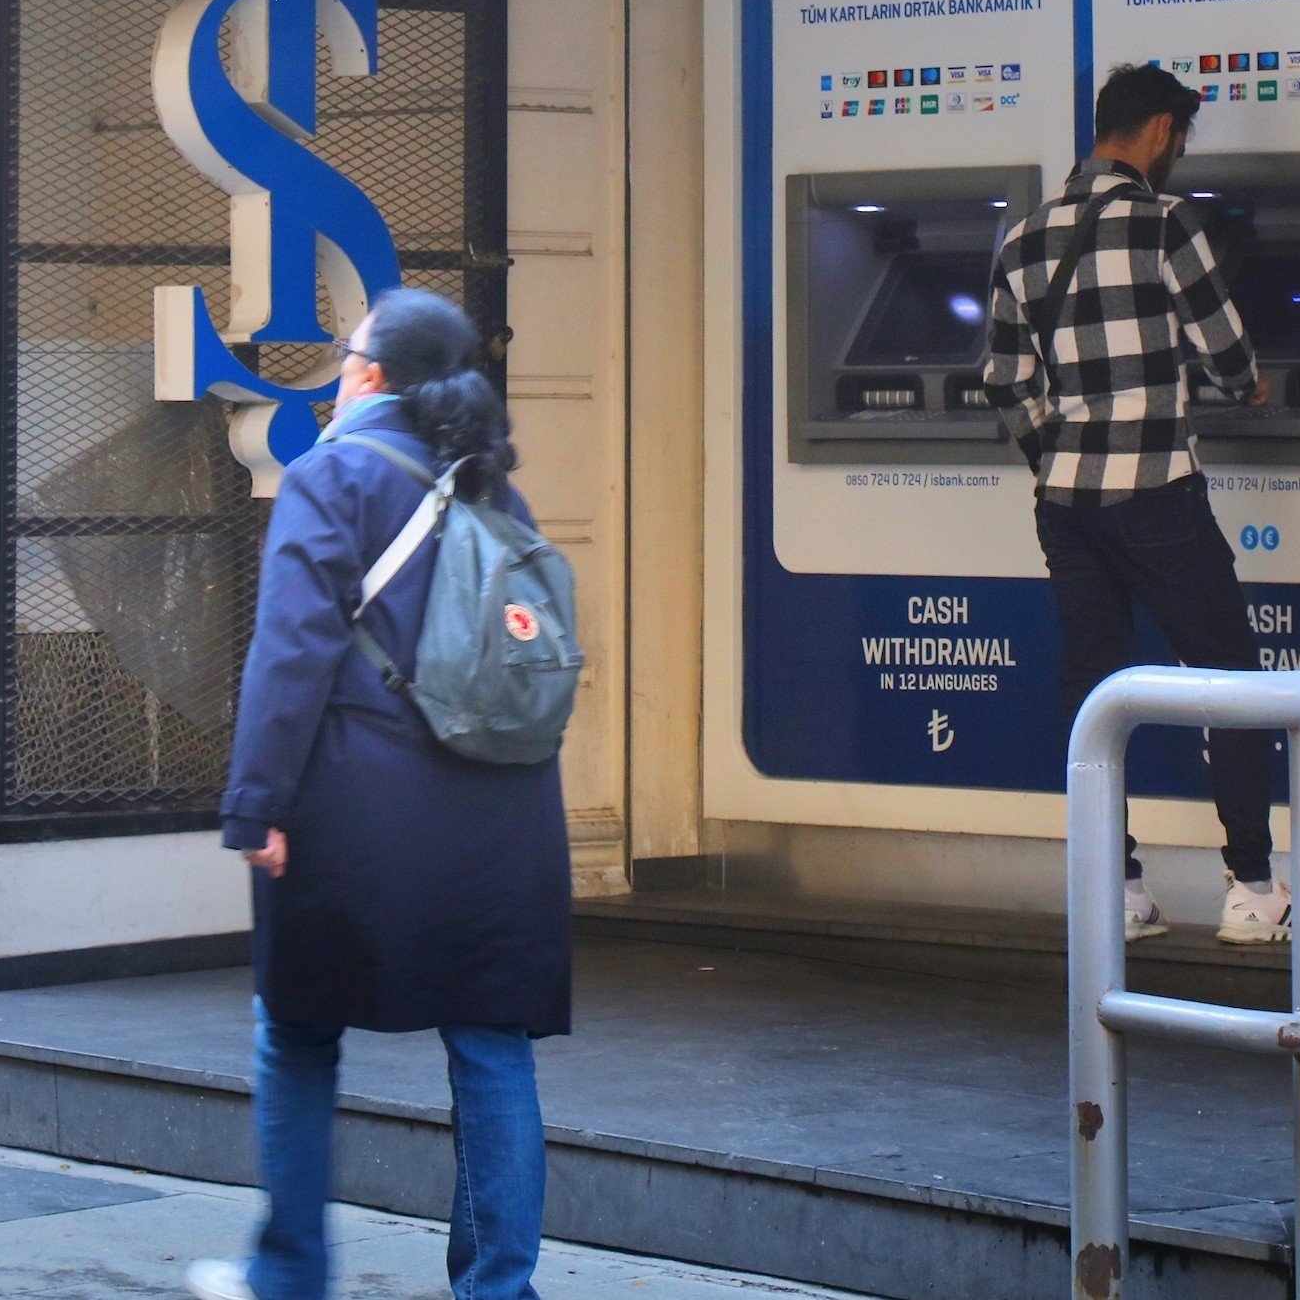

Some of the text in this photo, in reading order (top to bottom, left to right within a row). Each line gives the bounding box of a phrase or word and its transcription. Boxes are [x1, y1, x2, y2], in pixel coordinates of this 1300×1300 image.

[801, 5, 827, 24] TÜM
[830, 2, 900, 22] KARTLARIN
[904, 0, 945, 18] ORTAK
[1000, 95, 1016, 105] DCC
[846, 475, 868, 486] 0850
[871, 473, 890, 486] 724
[892, 473, 899, 486] 0
[902, 473, 921, 486] 724
[930, 473, 1000, 487] isbank.com.tr
[1207, 478, 1224, 491] 24
[1227, 478, 1234, 491] 0
[1237, 478, 1258, 491] 724
[907, 596, 968, 625] CASH
[1246, 604, 1292, 634] ASH
[862, 637, 1016, 667] WITHDRAWAL
[880, 673, 998, 692] IN 12 LANGUAGES
